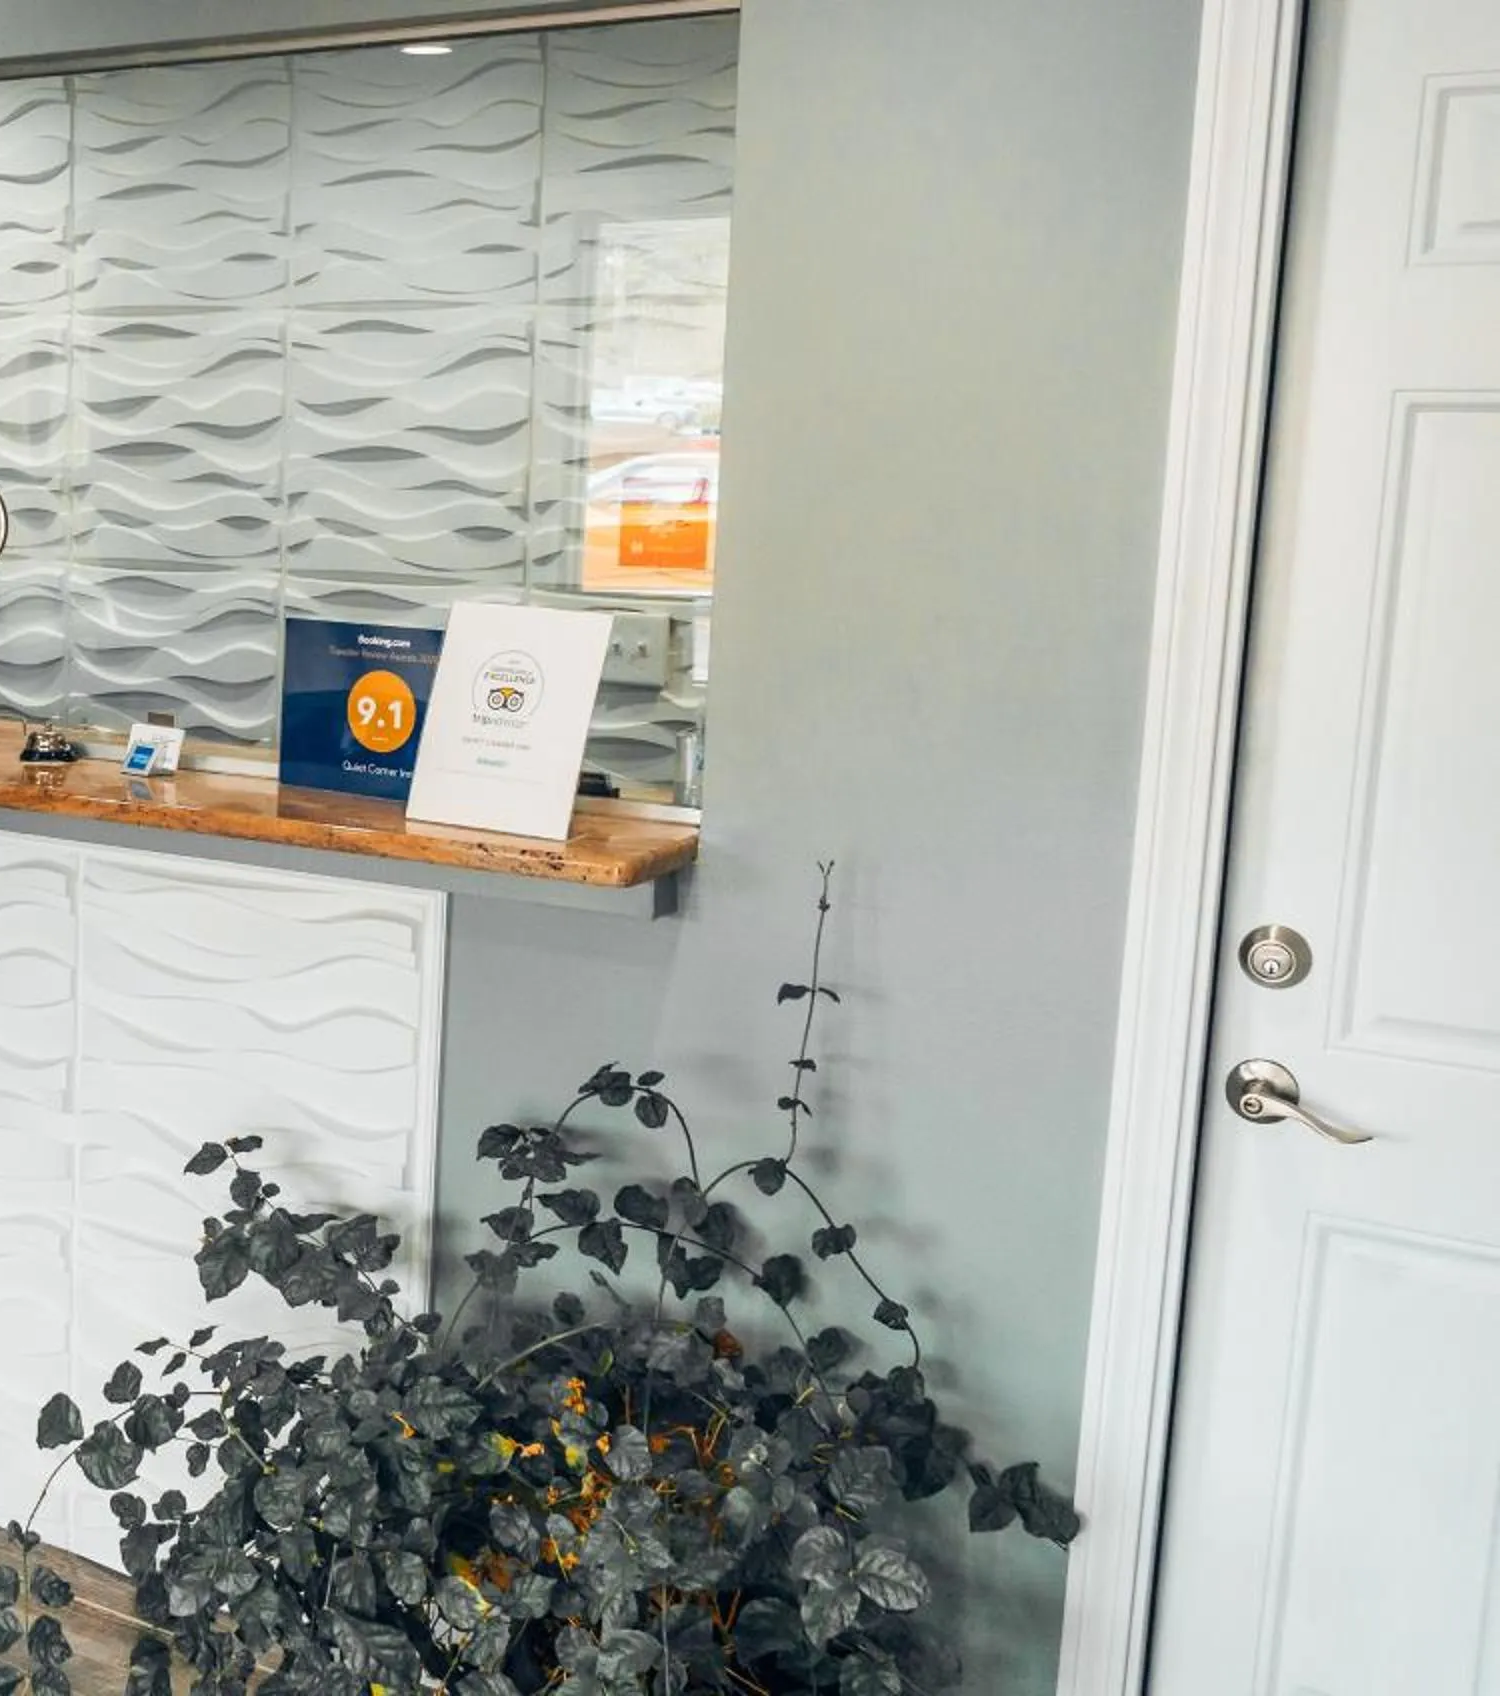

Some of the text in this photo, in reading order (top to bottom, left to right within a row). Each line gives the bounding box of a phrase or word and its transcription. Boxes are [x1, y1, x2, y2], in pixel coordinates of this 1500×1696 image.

[357, 634, 411, 648] Booking.com
[357, 695, 403, 730] 9.1
[343, 759, 366, 773] Quiet
[367, 763, 399, 776] Corner
